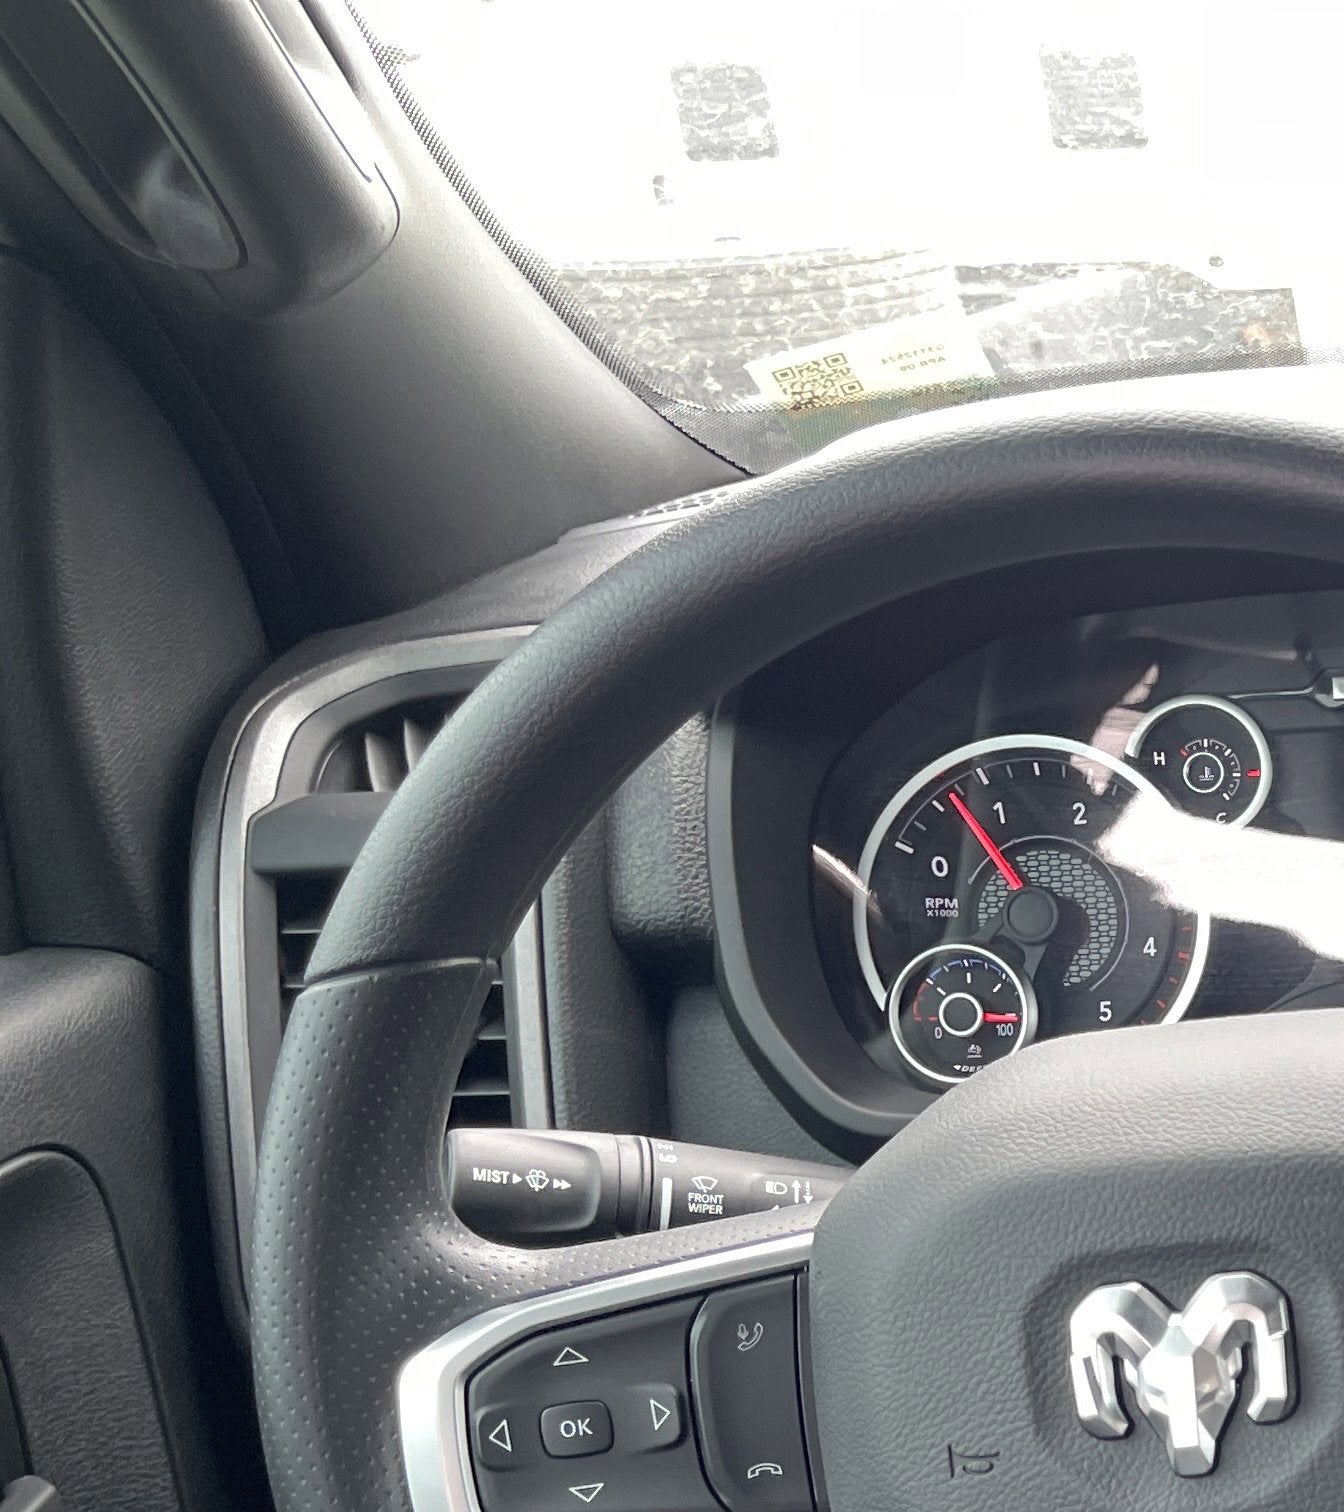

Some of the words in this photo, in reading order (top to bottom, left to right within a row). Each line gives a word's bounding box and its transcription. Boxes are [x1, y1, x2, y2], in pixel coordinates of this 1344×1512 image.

[1153, 751, 1166, 766] H
[993, 803, 1007, 823] 1
[1072, 803, 1087, 825] 2
[1215, 811, 1227, 825] C
[931, 857, 949, 878] 0
[925, 897, 959, 909] RPM
[1142, 937, 1158, 957] 4
[1099, 1001, 1112, 1022] 5
[996, 1023, 1014, 1037] 100
[472, 1167, 511, 1185] MIST
[687, 1192, 725, 1205] FRONT
[688, 1202, 724, 1215] WIPER
[559, 1418, 594, 1439] OK
